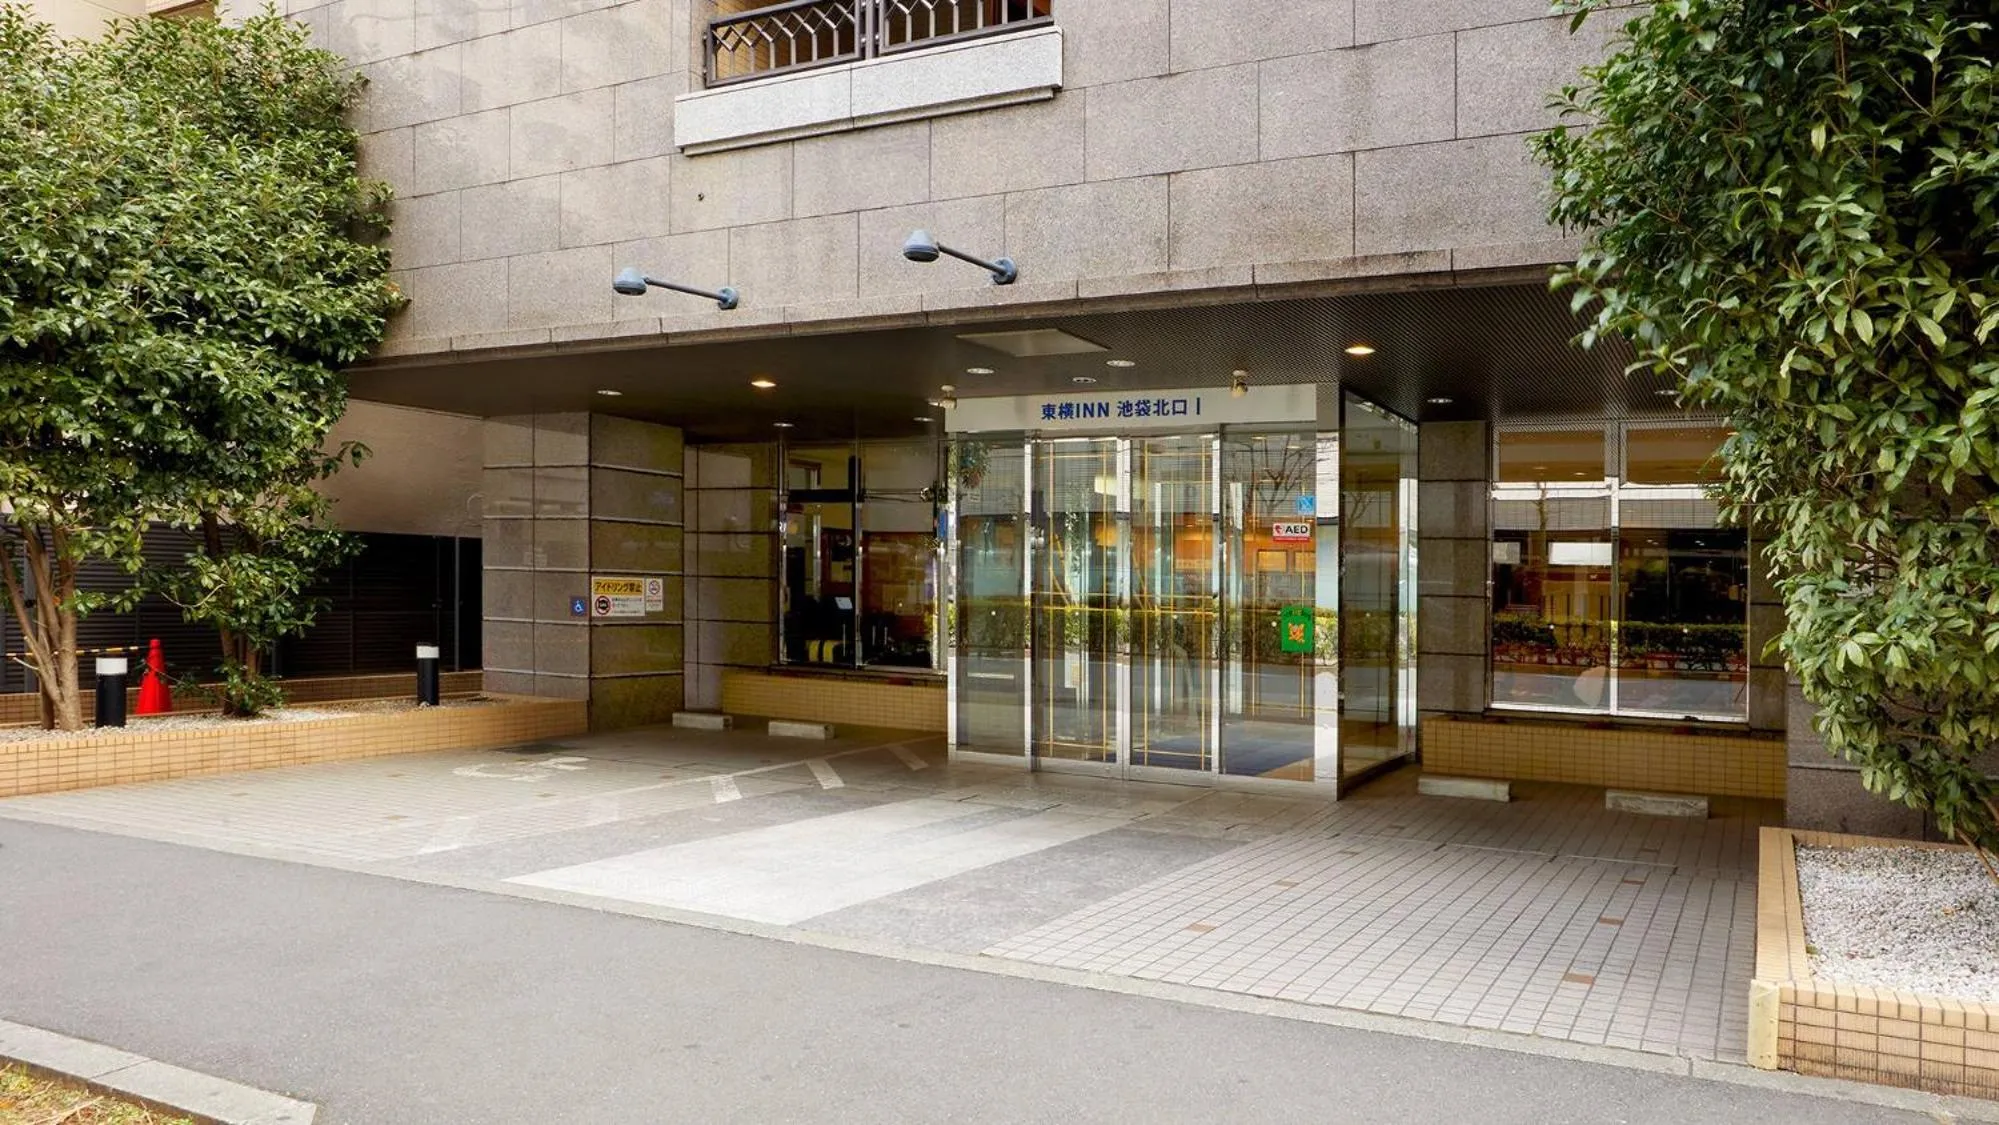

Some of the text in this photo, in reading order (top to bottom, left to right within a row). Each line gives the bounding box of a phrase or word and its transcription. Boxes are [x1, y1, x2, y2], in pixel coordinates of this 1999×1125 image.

[1041, 402, 1110, 420] 東横INN
[1117, 399, 1187, 417] 池袋北口
[1285, 525, 1309, 534] AED
[594, 581, 643, 593] アイドリング禁止
